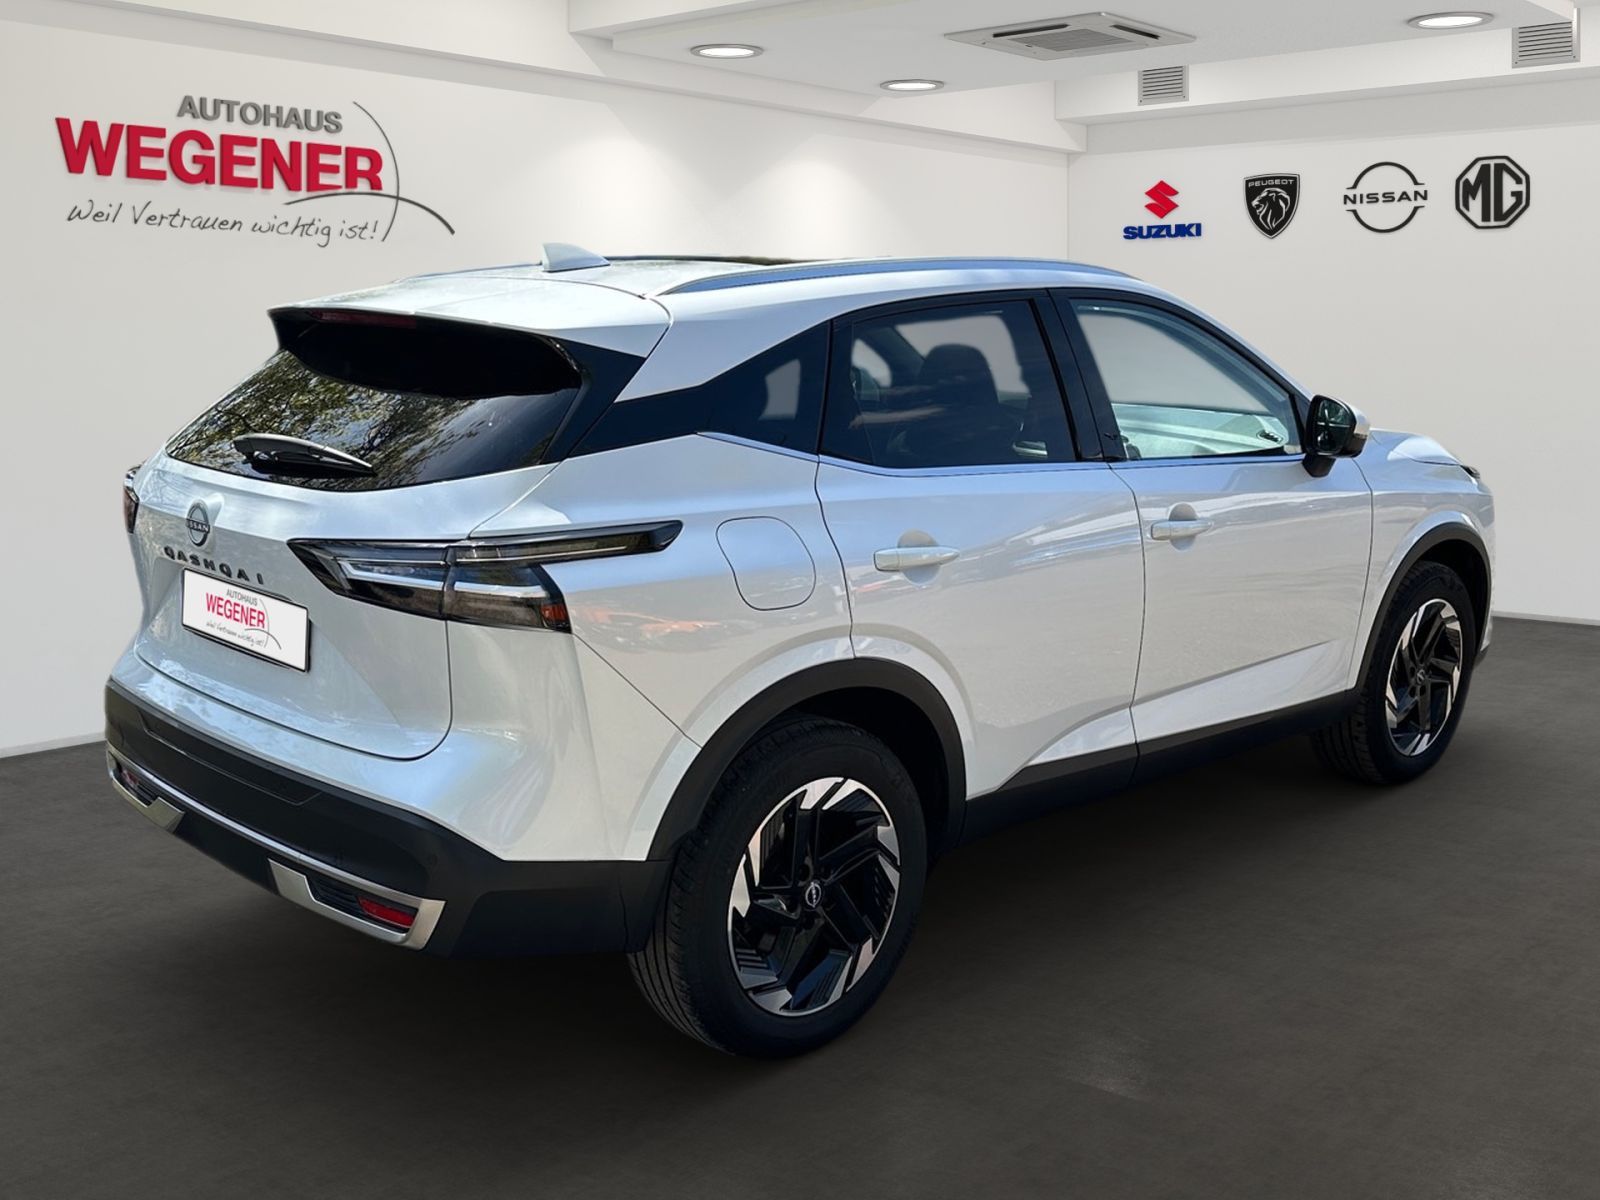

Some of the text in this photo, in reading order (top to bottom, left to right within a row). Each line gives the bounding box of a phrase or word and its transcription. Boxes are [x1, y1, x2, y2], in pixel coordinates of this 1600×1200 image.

[177, 95, 342, 133] AUTOHAUS
[55, 117, 383, 192] WEGENER
[1248, 178, 1296, 188] PEUGEOT
[1343, 189, 1428, 206] NISSAN
[1462, 163, 1524, 223] MG
[67, 199, 379, 247] Weil Vertrauen wichtig ist!
[1123, 223, 1202, 240] SUZUKI
[163, 545, 264, 585] QASHQAI
[205, 592, 266, 629] WEGENER
[226, 588, 258, 607] AUTOHAUS
